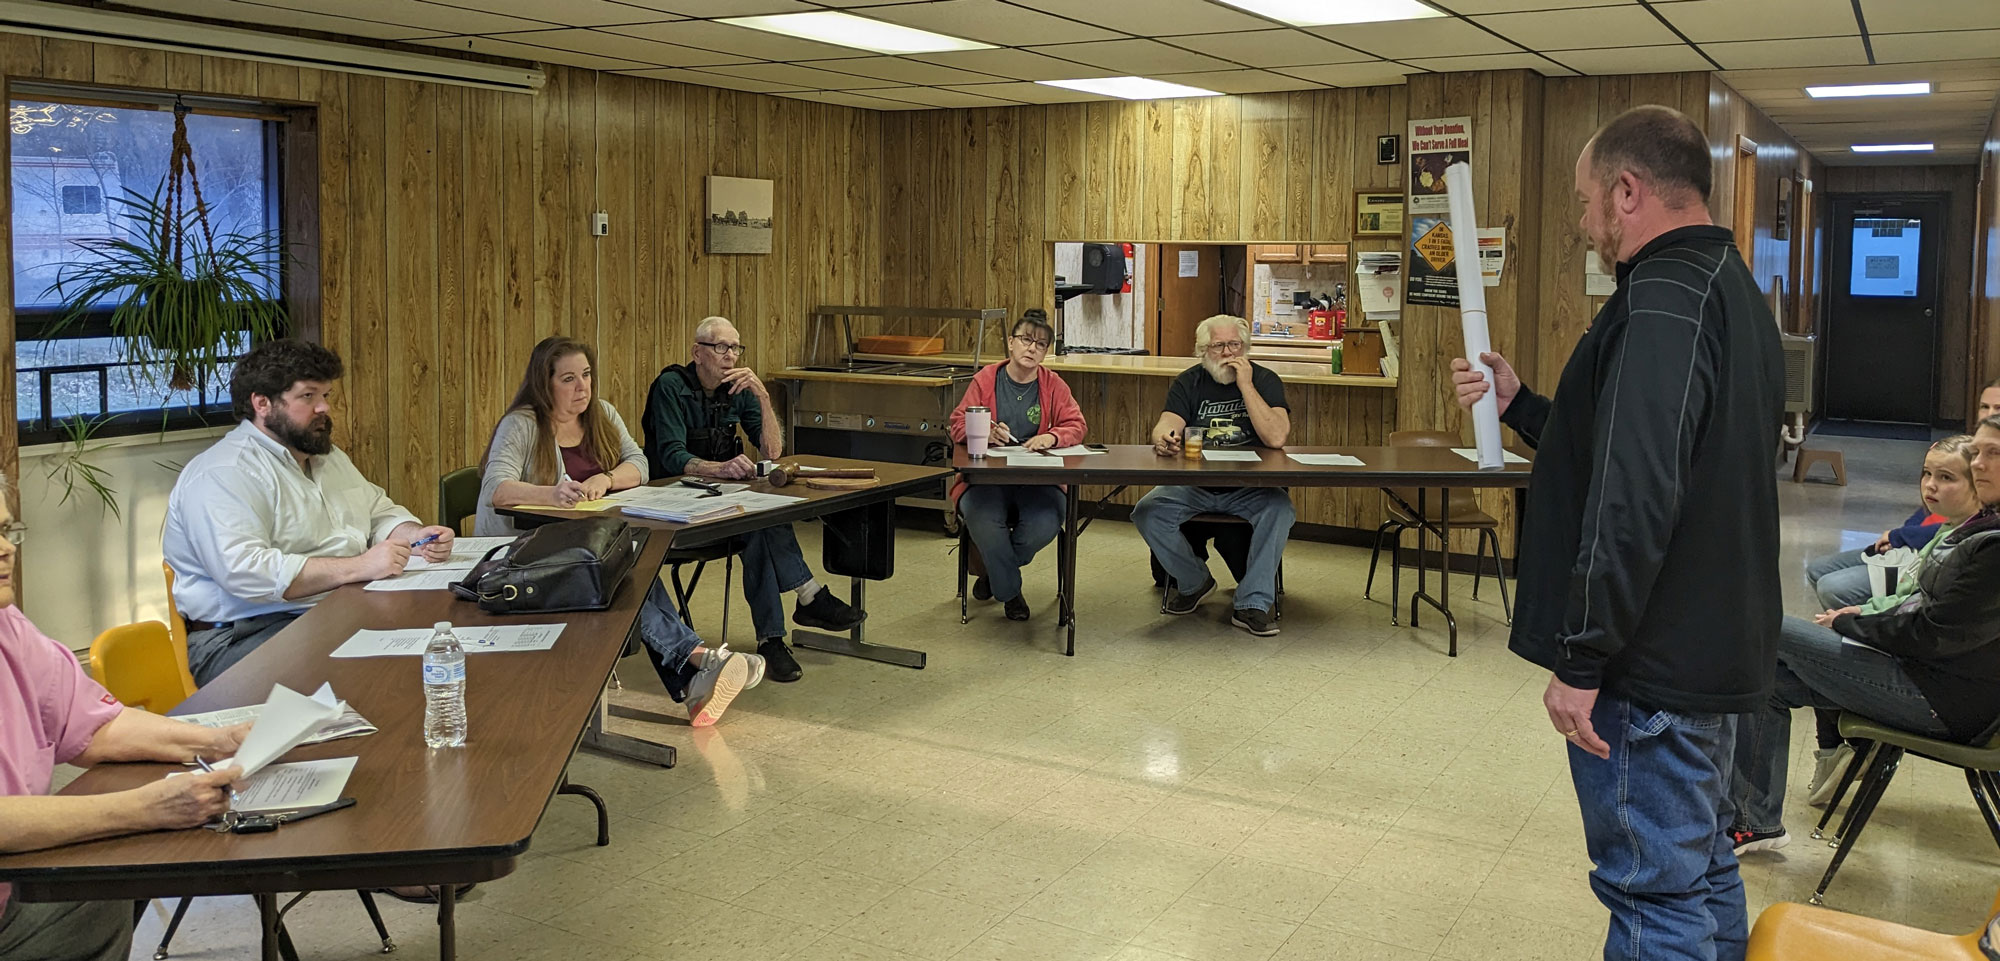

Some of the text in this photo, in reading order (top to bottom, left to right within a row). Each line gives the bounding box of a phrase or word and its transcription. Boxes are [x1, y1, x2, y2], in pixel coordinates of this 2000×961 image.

[1415, 125, 1433, 136] Without
[1434, 125, 1443, 135] Your
[1412, 140, 1419, 151] We
[1420, 139, 1431, 150] Can't
[1432, 139, 1445, 150] Serve
[1449, 138, 1457, 148] Full
[1457, 137, 1468, 148] Meal
